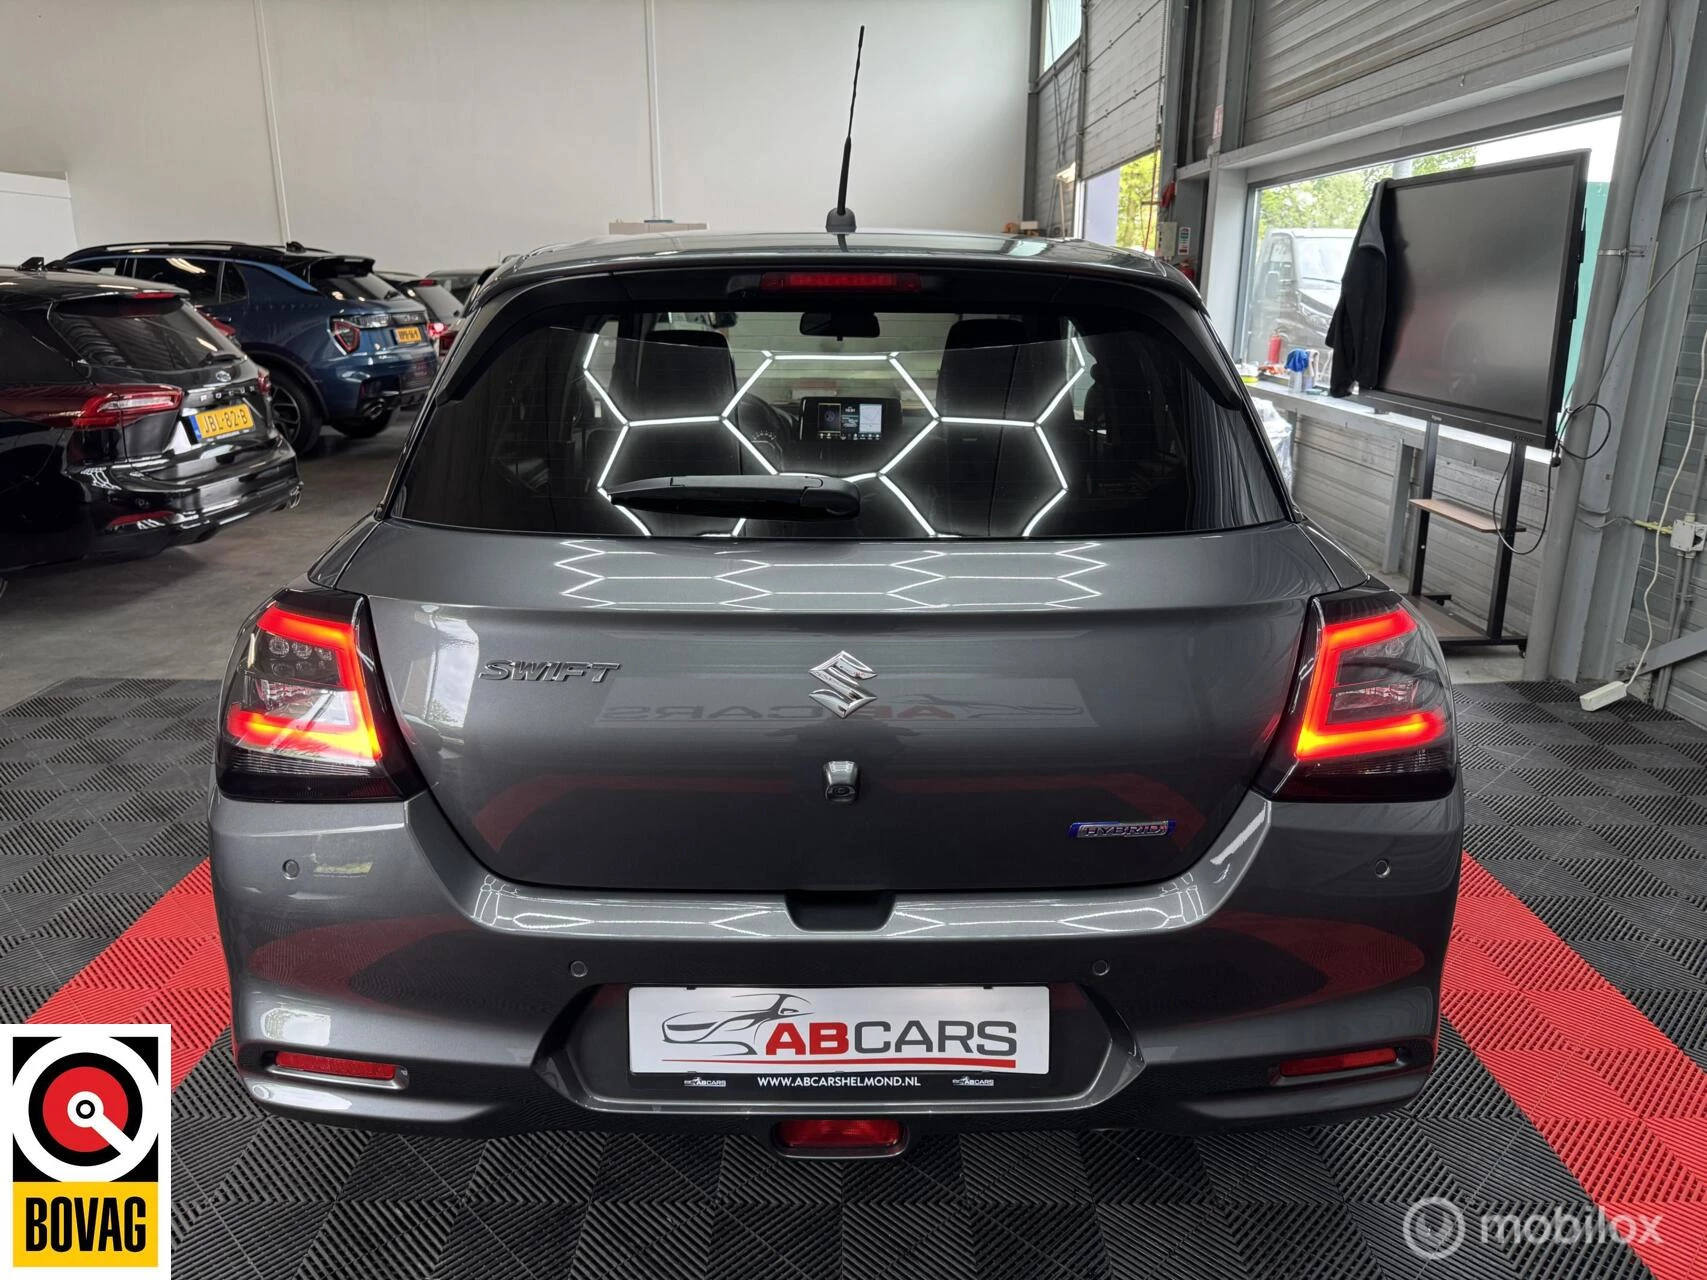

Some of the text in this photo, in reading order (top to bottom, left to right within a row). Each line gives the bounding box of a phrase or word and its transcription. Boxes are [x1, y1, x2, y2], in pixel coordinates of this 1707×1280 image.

[478, 660, 621, 683] SWIFT
[1083, 824, 1168, 838] HYBRID
[765, 1020, 1016, 1056] ABCARS
[757, 1077, 921, 1087] WWW.ABCARSHELMOND.NL
